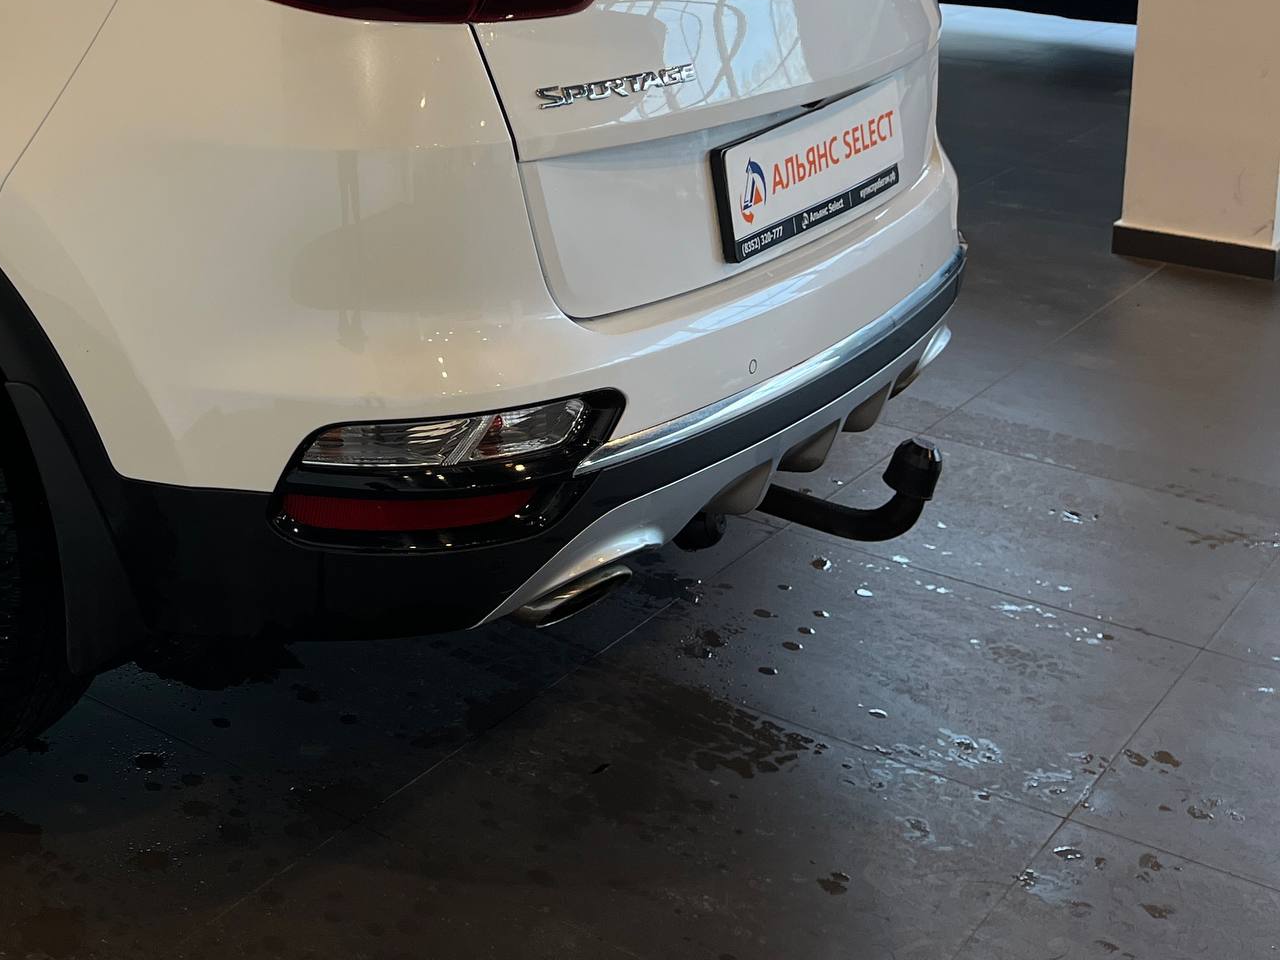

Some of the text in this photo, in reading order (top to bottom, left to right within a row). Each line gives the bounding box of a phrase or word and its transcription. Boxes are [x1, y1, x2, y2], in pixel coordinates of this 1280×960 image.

[535, 64, 697, 109] SPORTAGE
[773, 110, 894, 195] АЛЬЯНС SELECT
[741, 237, 761, 257] (8352)
